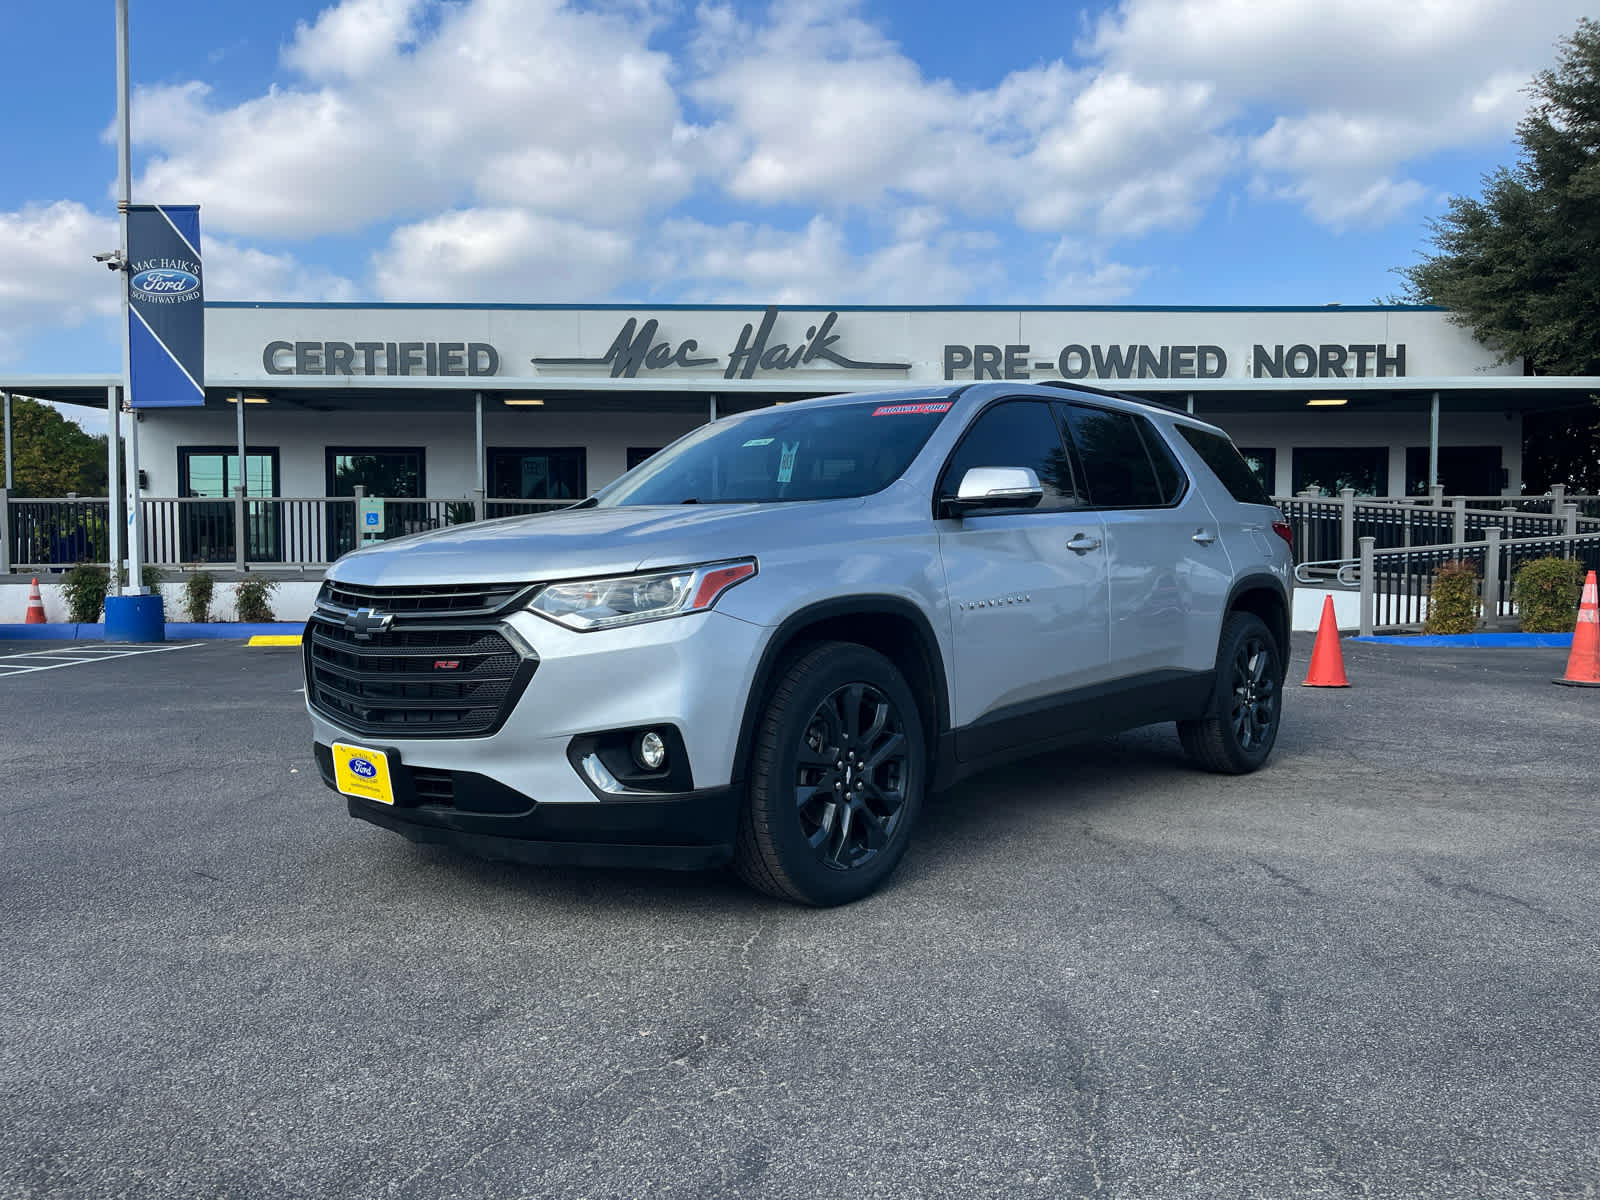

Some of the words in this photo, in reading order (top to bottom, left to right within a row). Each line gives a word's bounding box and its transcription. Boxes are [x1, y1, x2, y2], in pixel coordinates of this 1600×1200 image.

[131, 259, 157, 274] MAC
[161, 258, 200, 274] HAIK'S
[143, 272, 187, 291] Ford
[131, 291, 176, 304] SOUTHWAY
[177, 291, 200, 303] FORD
[531, 317, 718, 379] Mac
[723, 305, 912, 380] Haik
[262, 340, 499, 377] CERTIFIED
[943, 343, 1228, 380] PRE-OWNED
[1253, 343, 1407, 378] NORTH
[433, 660, 460, 669] RS
[354, 760, 373, 776] Ford
